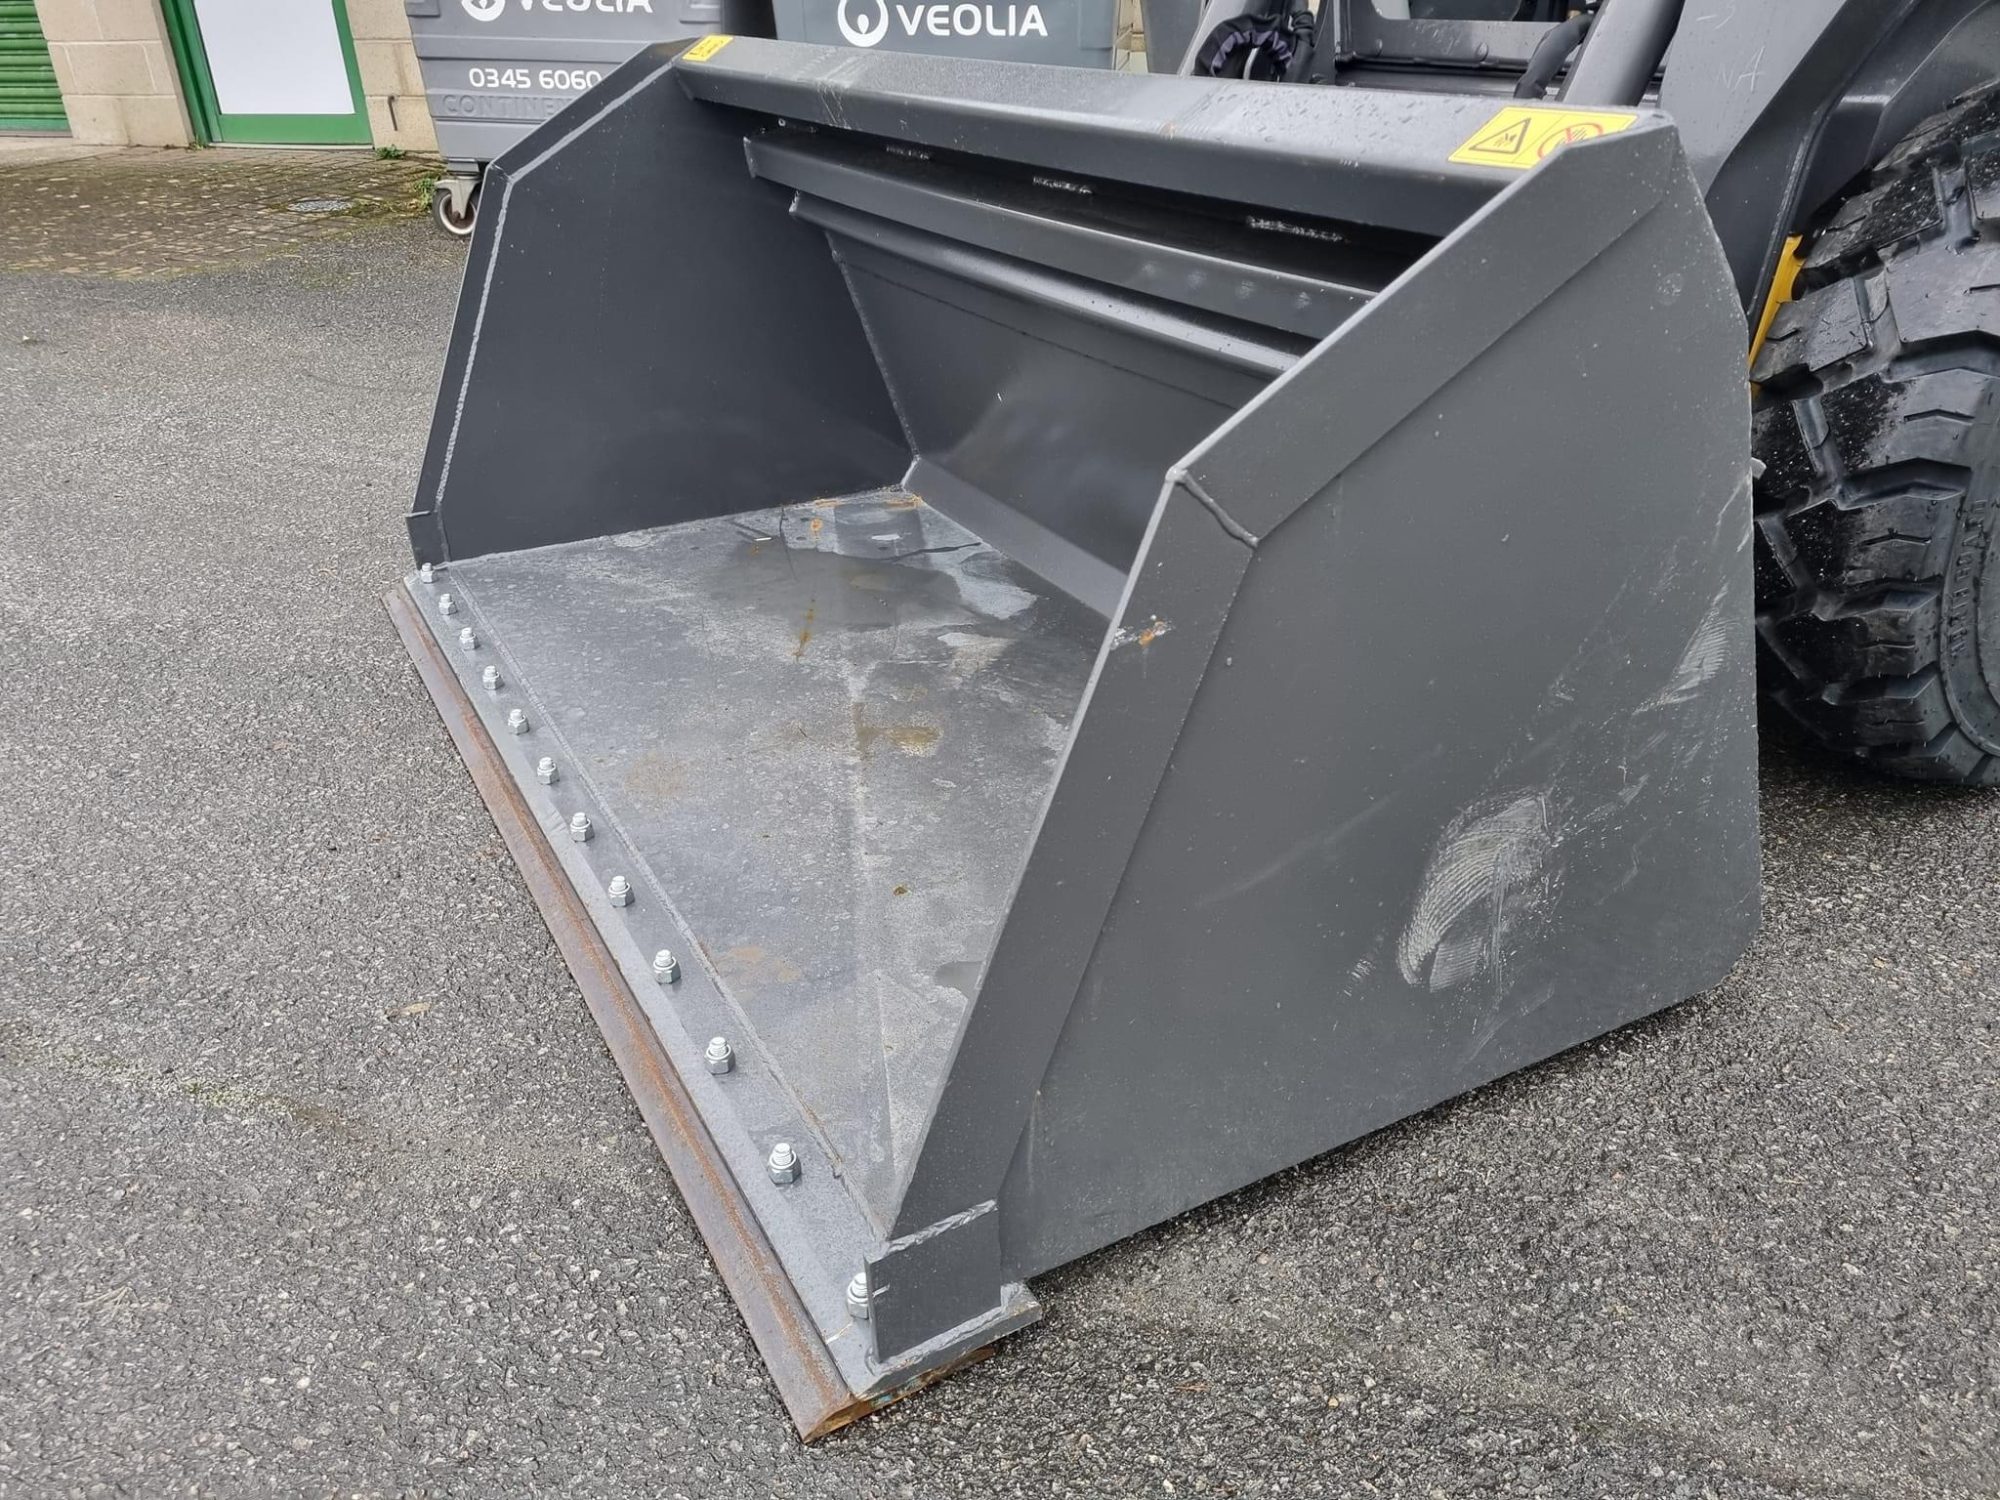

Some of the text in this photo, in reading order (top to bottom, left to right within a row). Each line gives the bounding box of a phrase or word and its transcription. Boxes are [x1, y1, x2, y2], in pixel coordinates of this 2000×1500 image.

[895, 3, 1049, 37] VEOLIA
[468, 67, 603, 90] 0345 6060
